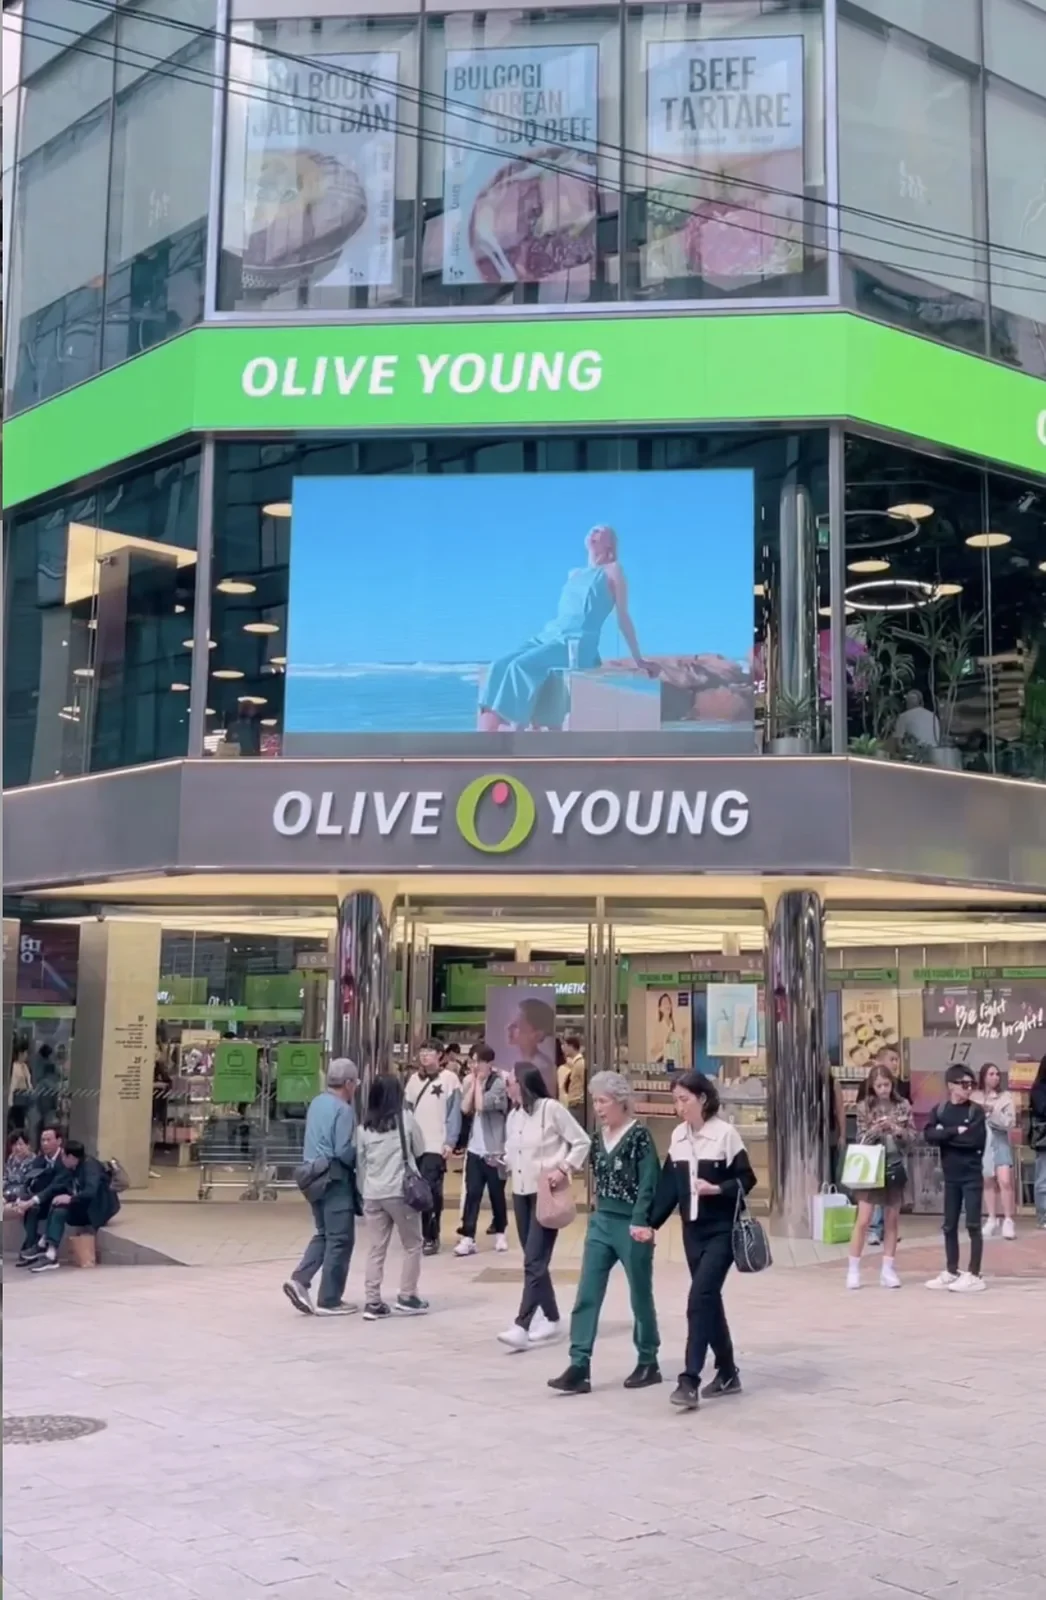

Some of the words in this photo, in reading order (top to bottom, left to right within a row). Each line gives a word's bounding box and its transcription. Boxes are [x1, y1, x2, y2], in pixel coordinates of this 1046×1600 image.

[453, 63, 542, 92] BULGOGI
[688, 55, 758, 93] BEEF
[544, 116, 593, 144] BEEF
[660, 92, 792, 133] TARTARE
[241, 355, 399, 398] OLIVE
[417, 349, 603, 395] YOUNG
[272, 790, 444, 836] OLIVE
[545, 789, 750, 837] YOUNG
[541, 982, 587, 995] SMETIC
